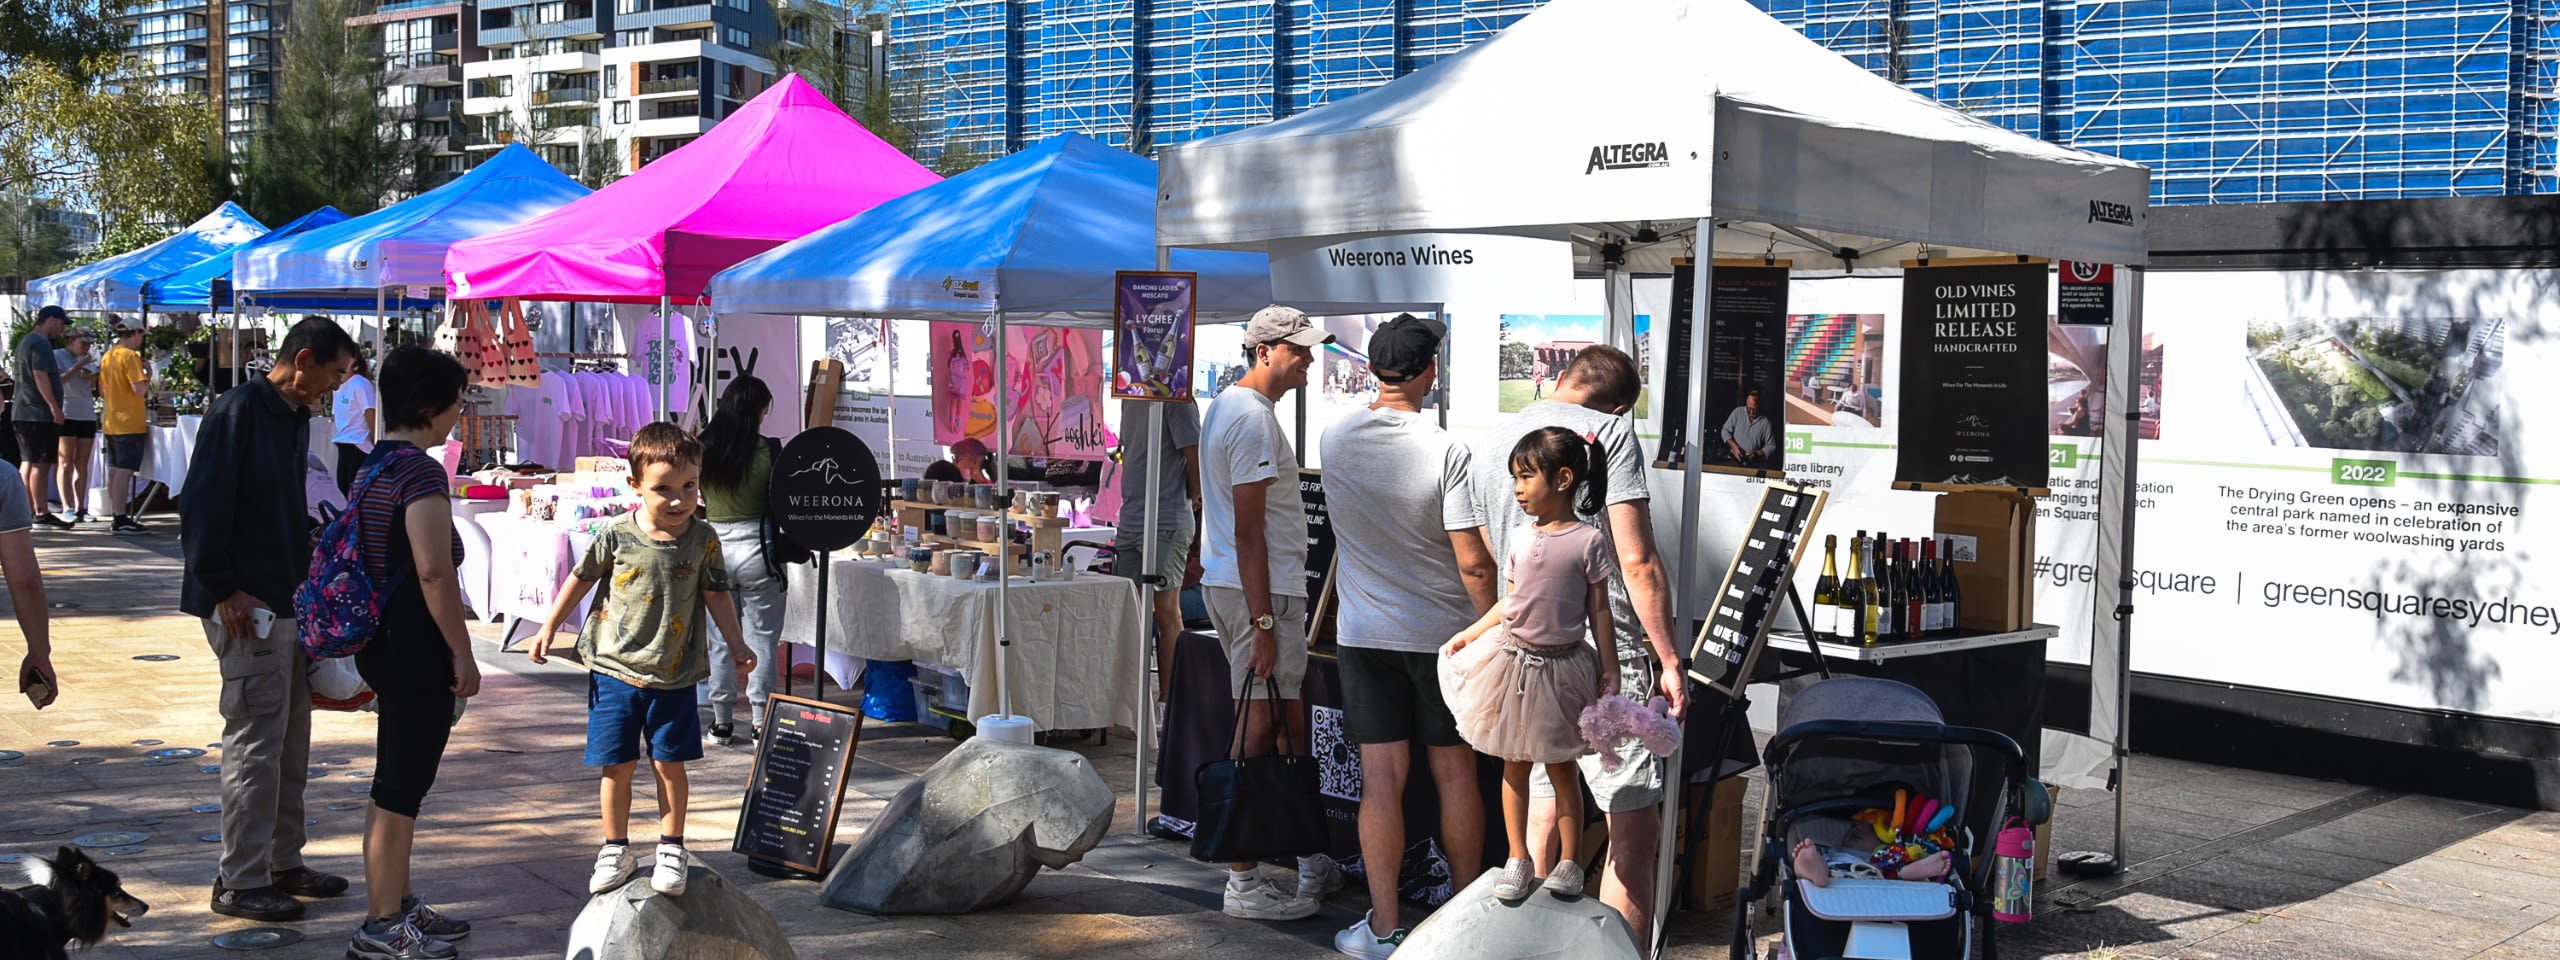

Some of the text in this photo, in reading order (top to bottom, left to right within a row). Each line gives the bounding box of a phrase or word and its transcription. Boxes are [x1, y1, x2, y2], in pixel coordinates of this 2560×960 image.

[1585, 142, 1668, 175] ALTEGRA
[2088, 200, 2133, 223] ALTEGRA
[1328, 244, 1473, 266] Weerona Wines
[1935, 284, 2016, 299] OLD VINES
[1136, 314, 1172, 324] LYCHEE
[1935, 302, 2016, 319] LIMITED
[1935, 322, 2017, 338] RELEASE
[1934, 343, 2017, 353] HANDCRAFTED
[1043, 412, 1104, 456] Kooshki
[1810, 462, 1844, 477] library
[2340, 464, 2386, 482] 2022
[2074, 478, 2098, 489] and
[789, 495, 864, 507] WEERONA
[2218, 485, 2244, 499] The
[2248, 487, 2295, 505] Drying
[2300, 491, 2345, 506] Green
[2349, 494, 2396, 510] opens
[2413, 500, 2432, 512] an
[2437, 501, 2519, 517] expansive
[2054, 507, 2099, 521] Square
[2230, 504, 2503, 534] central park named in celebration of
[2226, 519, 2505, 552] the area's former woolwashing yards
